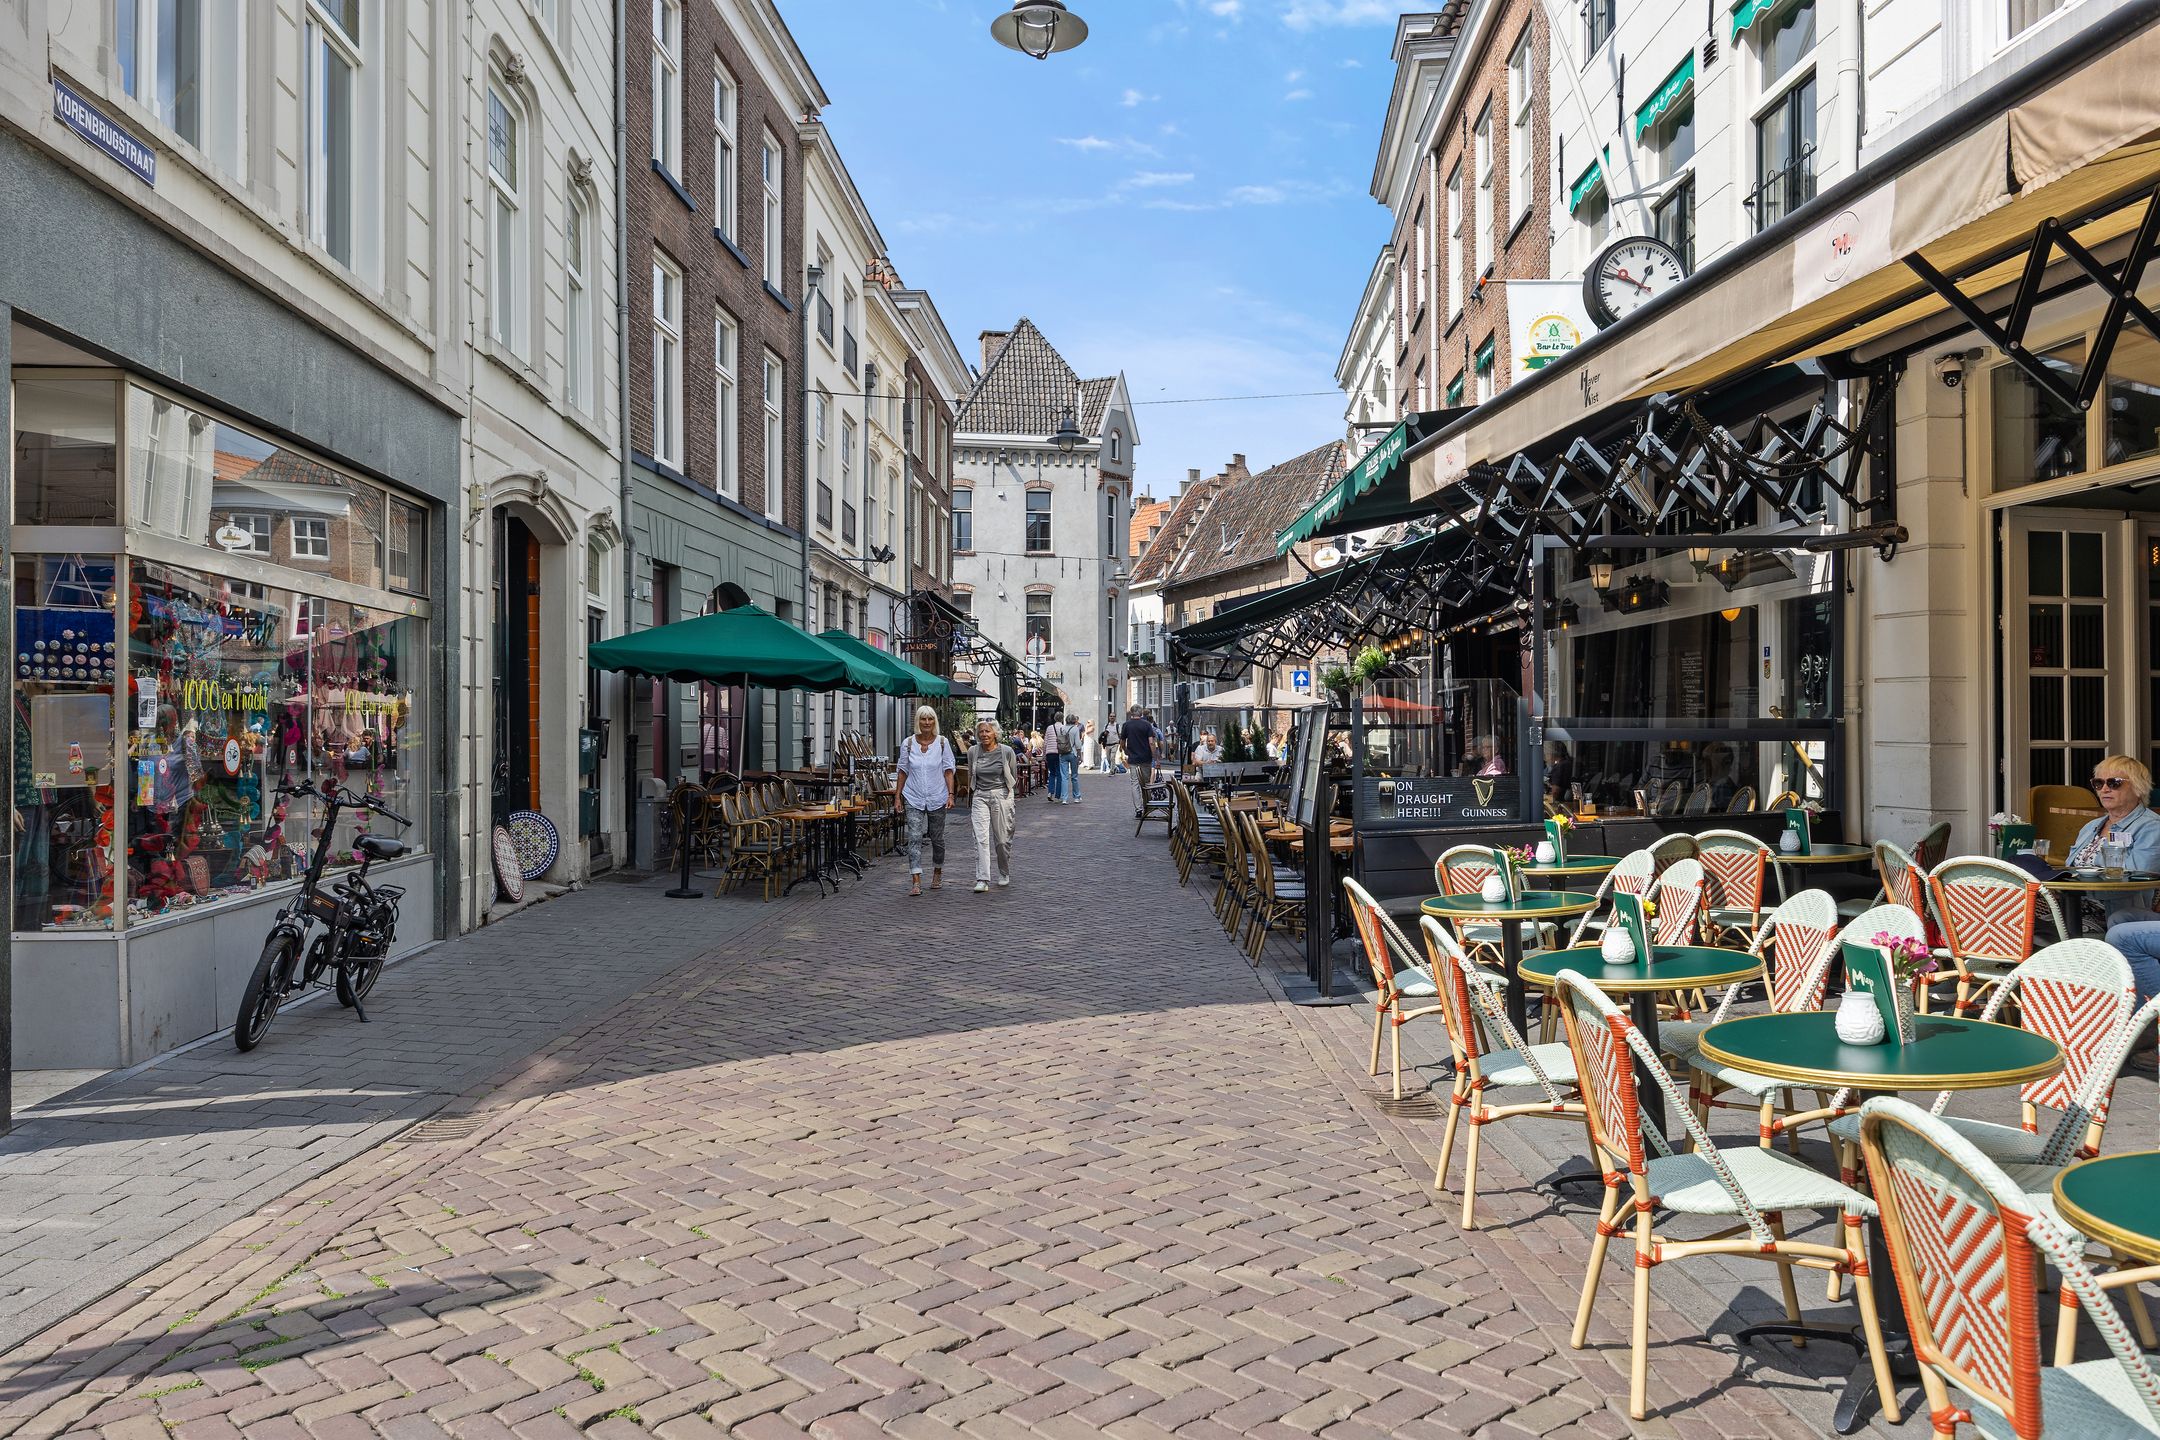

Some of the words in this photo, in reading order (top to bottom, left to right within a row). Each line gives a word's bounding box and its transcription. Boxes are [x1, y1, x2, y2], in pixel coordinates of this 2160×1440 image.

[57, 89, 154, 176] KORENBRUGSTRAAT
[1536, 342, 1551, 351] Bar
[1552, 342, 1560, 351] Le
[1560, 342, 1574, 351] Duc
[1580, 369, 1601, 391] Haver
[184, 679, 220, 711] 1000
[222, 691, 233, 710] en
[242, 682, 268, 711] nacht
[1396, 781, 1413, 791] ON
[1397, 794, 1453, 804] DRAUGHT
[1397, 807, 1441, 818] HERE!!!
[1462, 807, 1507, 818] GUINNESS
